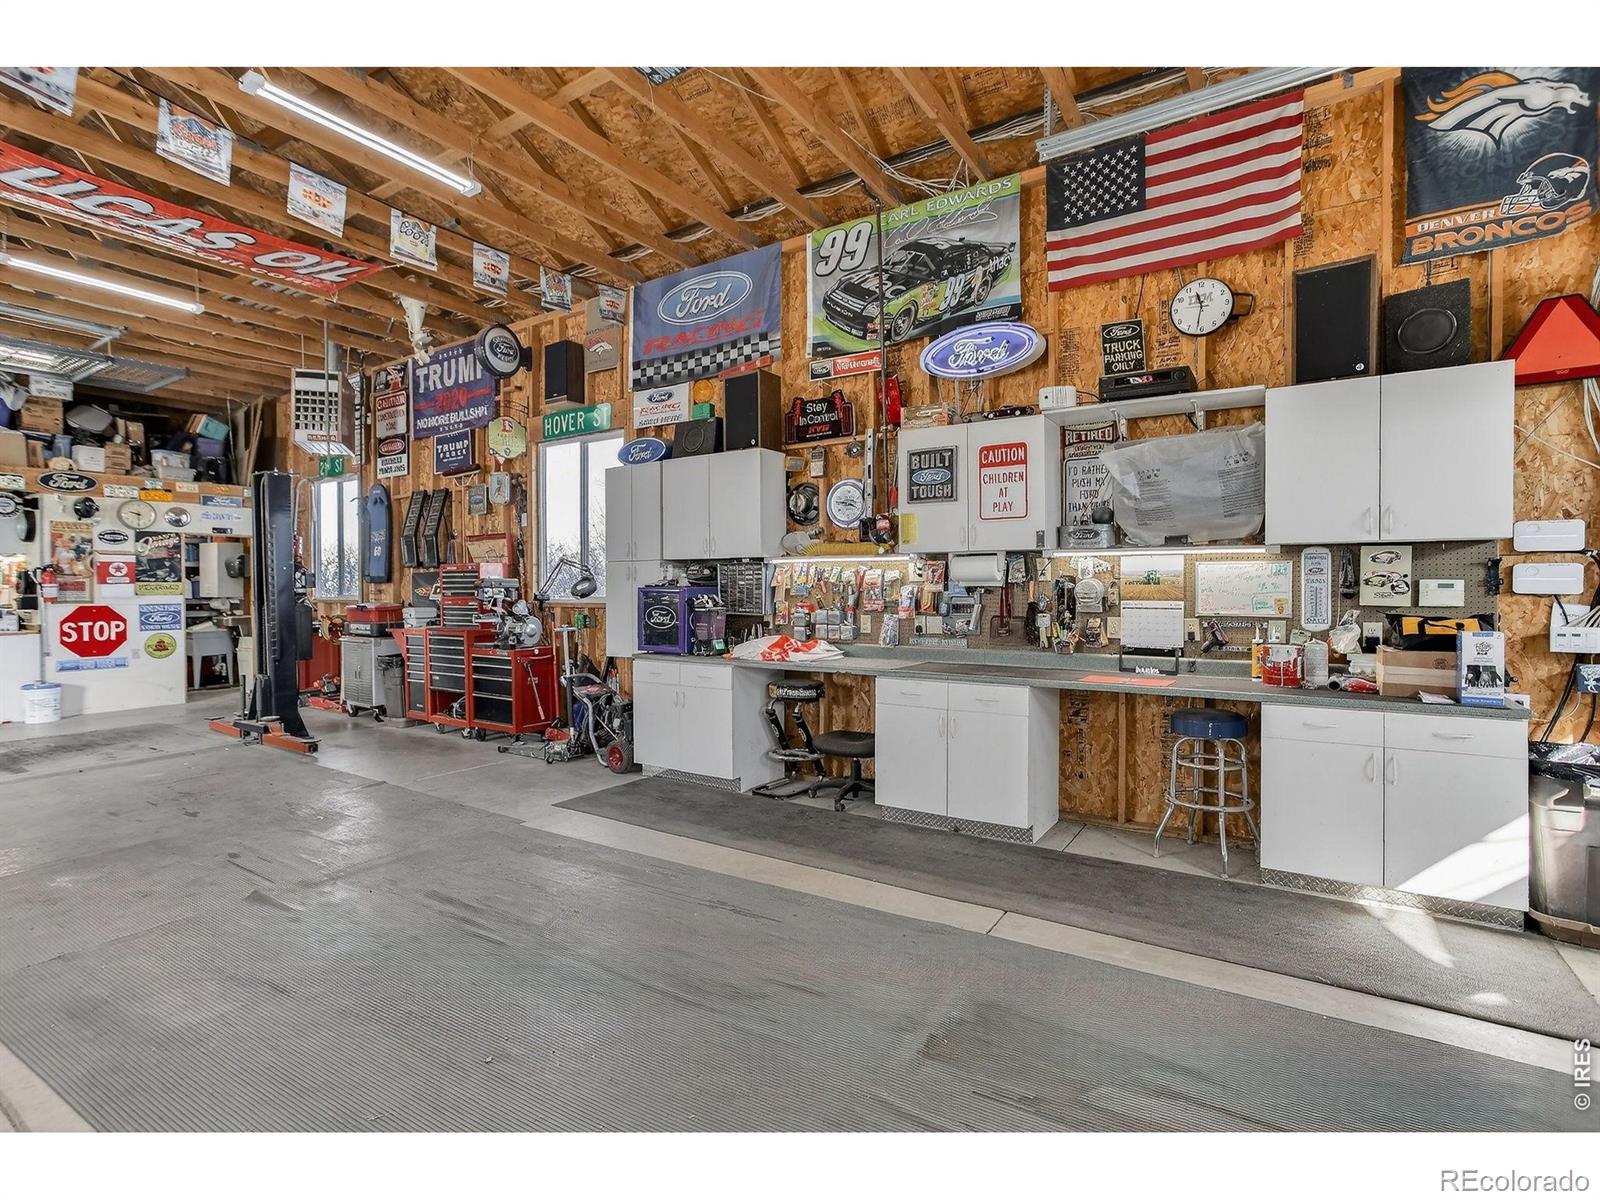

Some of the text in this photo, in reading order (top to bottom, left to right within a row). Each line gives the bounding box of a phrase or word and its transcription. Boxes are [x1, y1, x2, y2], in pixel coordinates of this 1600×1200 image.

[926, 180, 1013, 212] EDWARDS
[1417, 208, 1496, 233] DENVER
[1411, 203, 1592, 256] BRONCOS
[815, 221, 874, 277] 99
[253, 249, 370, 283] OIL
[675, 280, 734, 319] Ford
[938, 272, 967, 312] 99
[643, 310, 765, 356] RACING
[947, 336, 1010, 368] Ford
[1104, 339, 1141, 354] TRUCK
[1104, 350, 1143, 364] PARKING
[1112, 360, 1136, 372] ONLY
[639, 402, 682, 415] RACING
[806, 402, 828, 414] Stay
[544, 406, 609, 436] HOVER ST
[799, 410, 838, 426] In Control
[1065, 427, 1113, 445] RETIRED
[436, 439, 469, 453] TRUMP
[628, 444, 653, 463] Ford
[911, 450, 951, 469] BUILT
[981, 446, 1025, 465] CAUTION
[335, 458, 343, 474] ST
[1082, 464, 1108, 475] RATHE
[48, 472, 89, 490] Ford
[920, 470, 943, 482] Ford
[983, 471, 1024, 484] CHILDREN
[1072, 478, 1091, 488] PUSH
[911, 485, 952, 499] TOUGH
[998, 487, 1008, 498] AT
[1079, 490, 1099, 500] FORD
[992, 501, 1013, 513] PLAY
[1073, 530, 1094, 540] Ford
[149, 613, 173, 622] Ford
[650, 609, 672, 624] Ford
[61, 620, 125, 643] STOP
